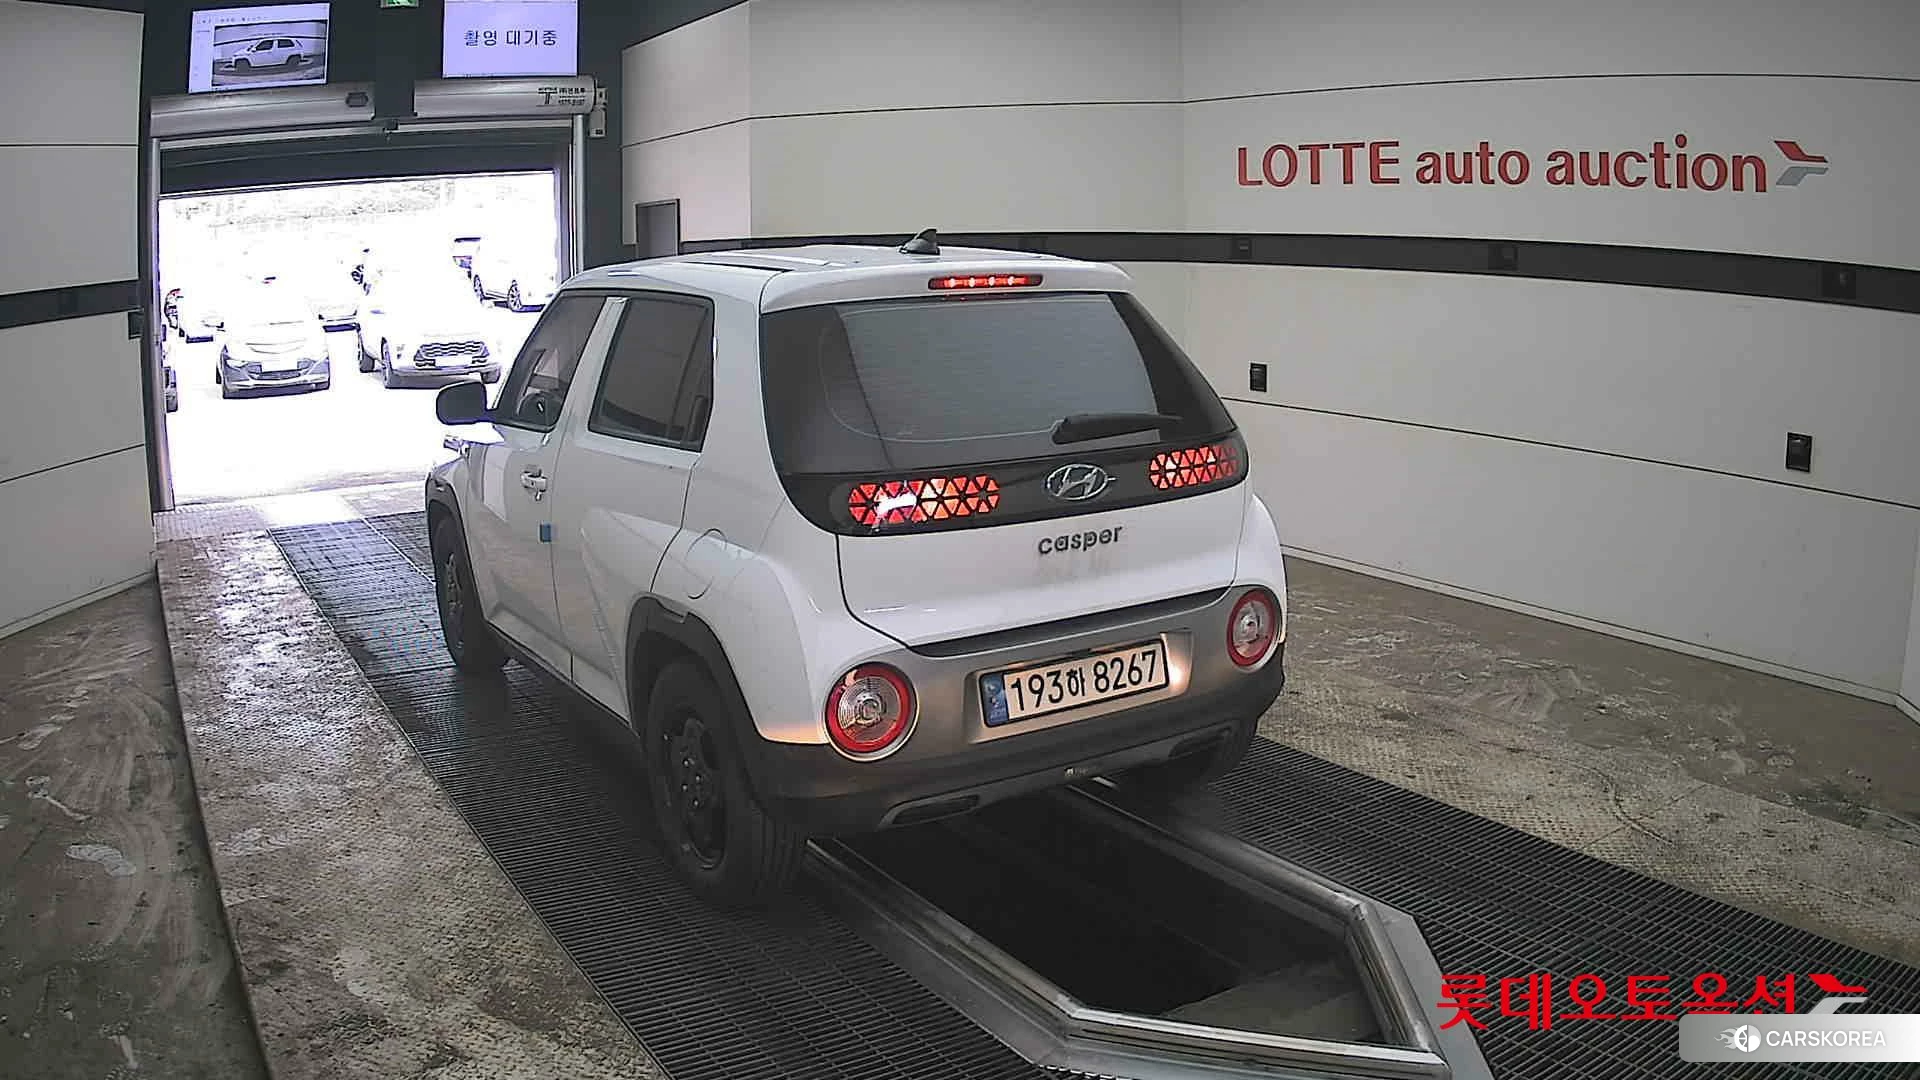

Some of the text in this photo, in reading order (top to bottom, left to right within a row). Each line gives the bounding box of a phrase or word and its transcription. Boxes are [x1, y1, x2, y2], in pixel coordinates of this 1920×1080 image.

[464, 29, 557, 47] 촬영 대기중
[1237, 133, 1768, 193] LOTTE auto auction
[1038, 525, 1124, 554] casper
[1011, 649, 1157, 712] 193하 8267
